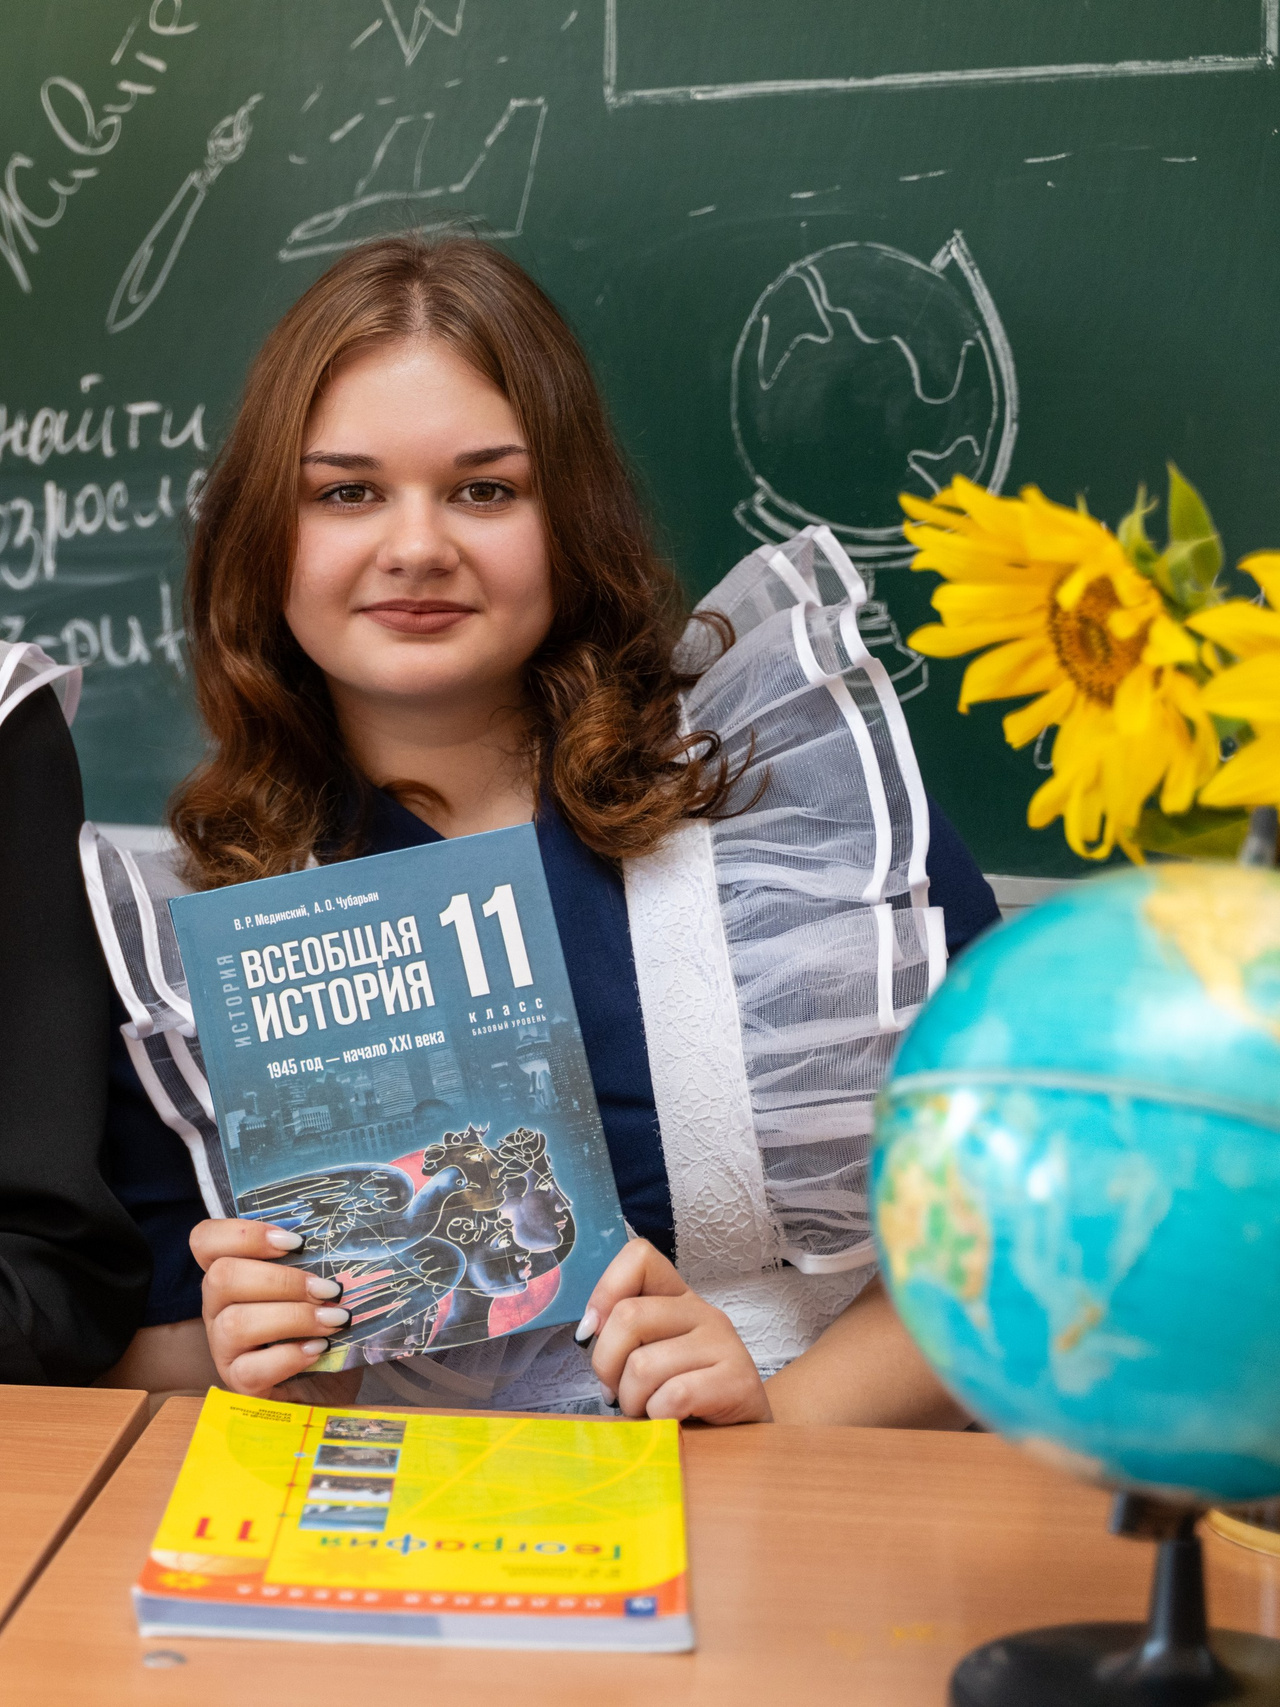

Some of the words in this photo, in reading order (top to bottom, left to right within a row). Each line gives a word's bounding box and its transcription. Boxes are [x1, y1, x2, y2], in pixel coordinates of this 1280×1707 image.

[233, 918, 245, 931] В.
[245, 915, 255, 929] Р.
[255, 904, 310, 927] Мединский,
[314, 900, 325, 914] А.
[325, 899, 336, 911] О.
[335, 891, 380, 910] Чубарьян
[438, 883, 534, 998] 11
[240, 915, 423, 990] ВСЕОБЩАЯ
[216, 954, 252, 1048] ИСТОРИЯ
[251, 960, 436, 1043] ИСТОРИЯ
[472, 1023, 509, 1037] БАЗОВЫЙ
[511, 1013, 547, 1029] УРОВЕНЬ
[267, 1056, 298, 1079] 1945
[300, 1056, 324, 1074] год
[343, 1040, 388, 1063] начало
[415, 1029, 445, 1048] века
[319, 1533, 624, 1561] География
